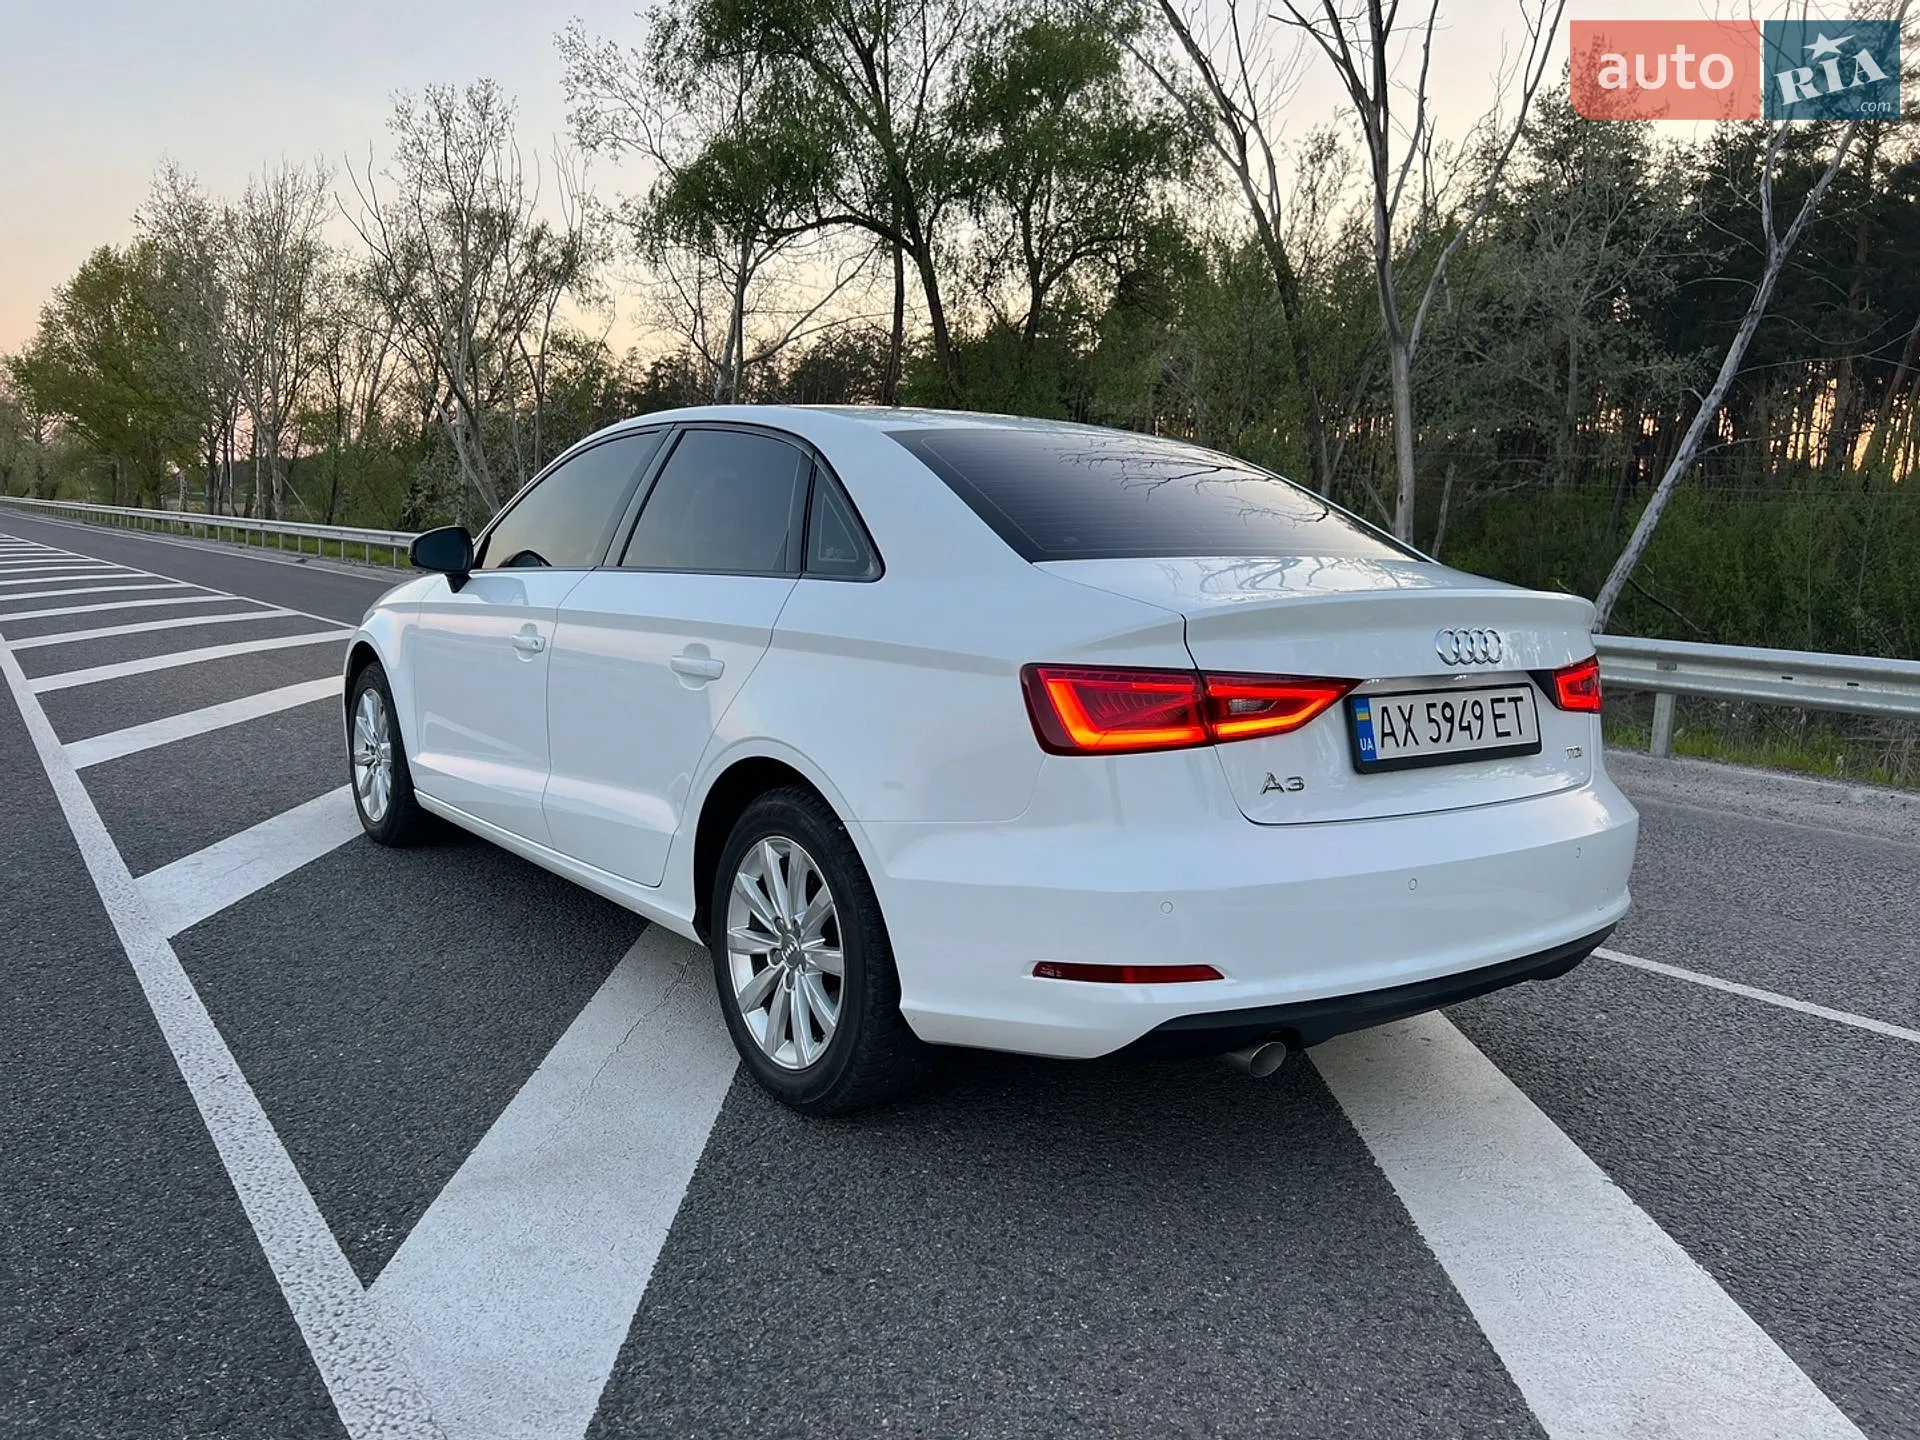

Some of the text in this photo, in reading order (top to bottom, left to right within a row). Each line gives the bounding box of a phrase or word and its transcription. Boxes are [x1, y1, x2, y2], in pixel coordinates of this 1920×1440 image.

[1380, 696, 1524, 748] AX 5949 ET
[1359, 738, 1374, 751] UA
[1260, 772, 1305, 795] A3
